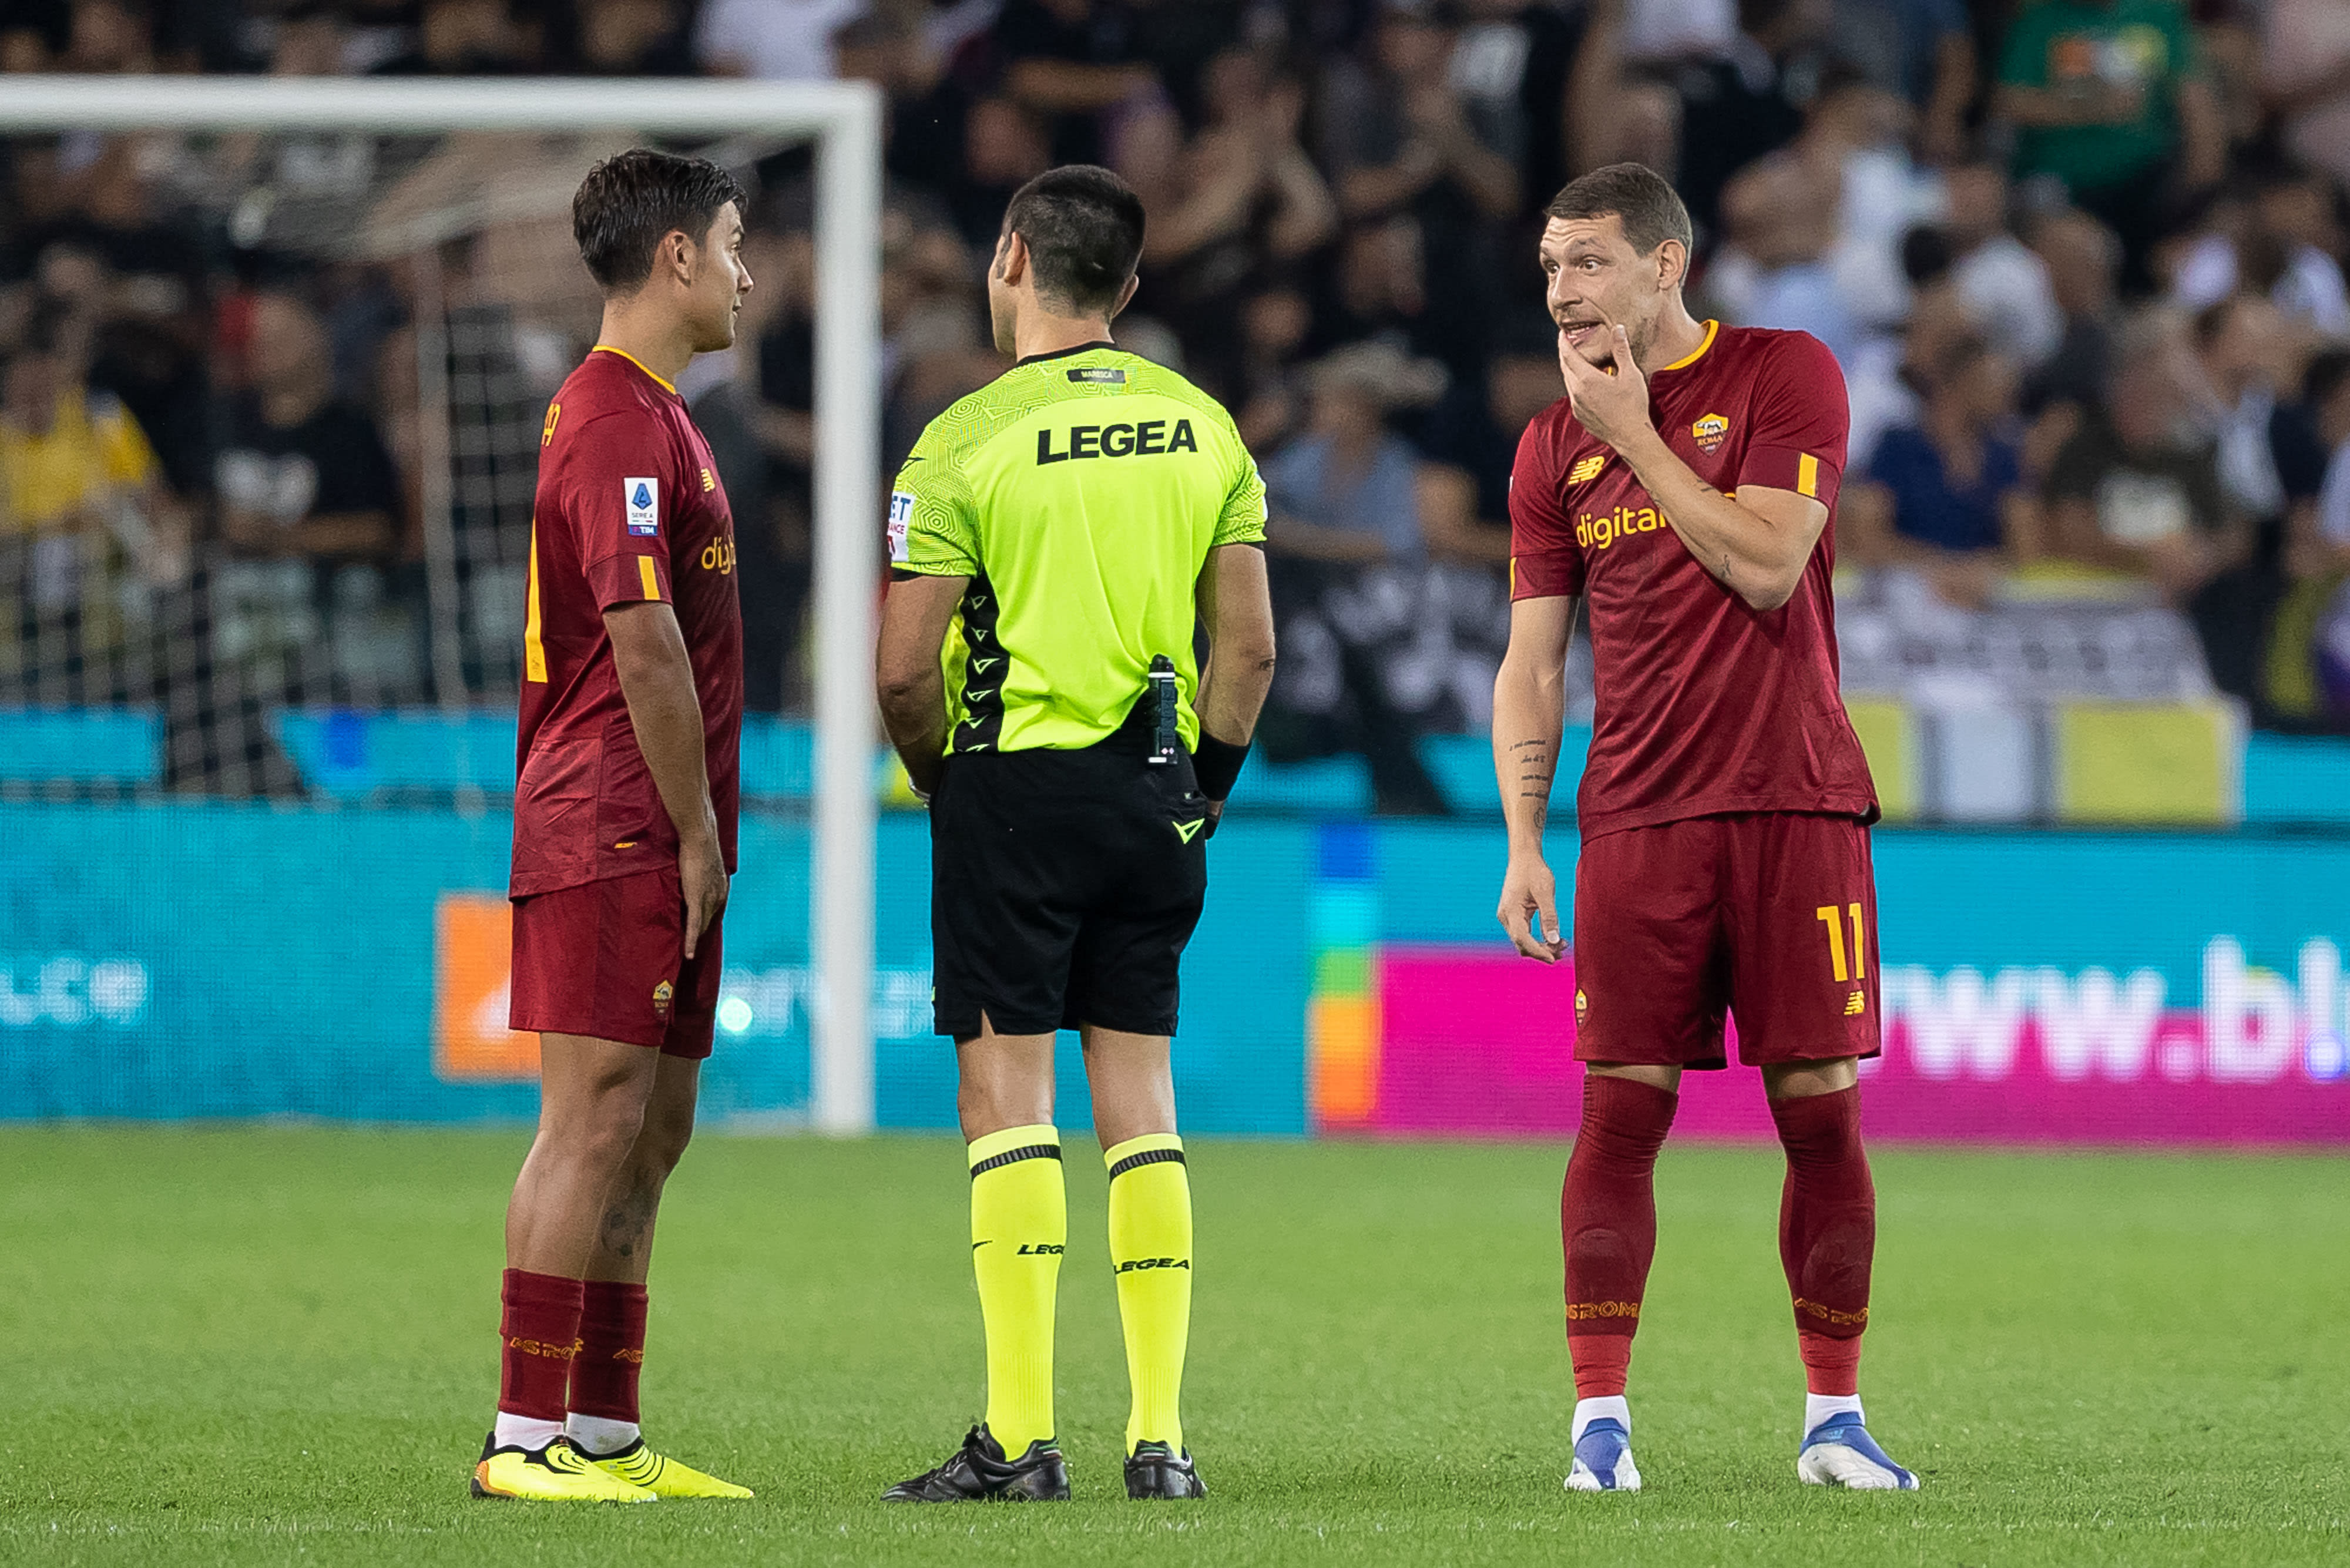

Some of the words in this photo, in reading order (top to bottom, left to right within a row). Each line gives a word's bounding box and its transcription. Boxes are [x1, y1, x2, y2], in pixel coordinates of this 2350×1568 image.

[1036, 419, 1198, 466] LEGEA
[1697, 435, 1723, 446] ROMA
[1817, 902, 1865, 982] 11
